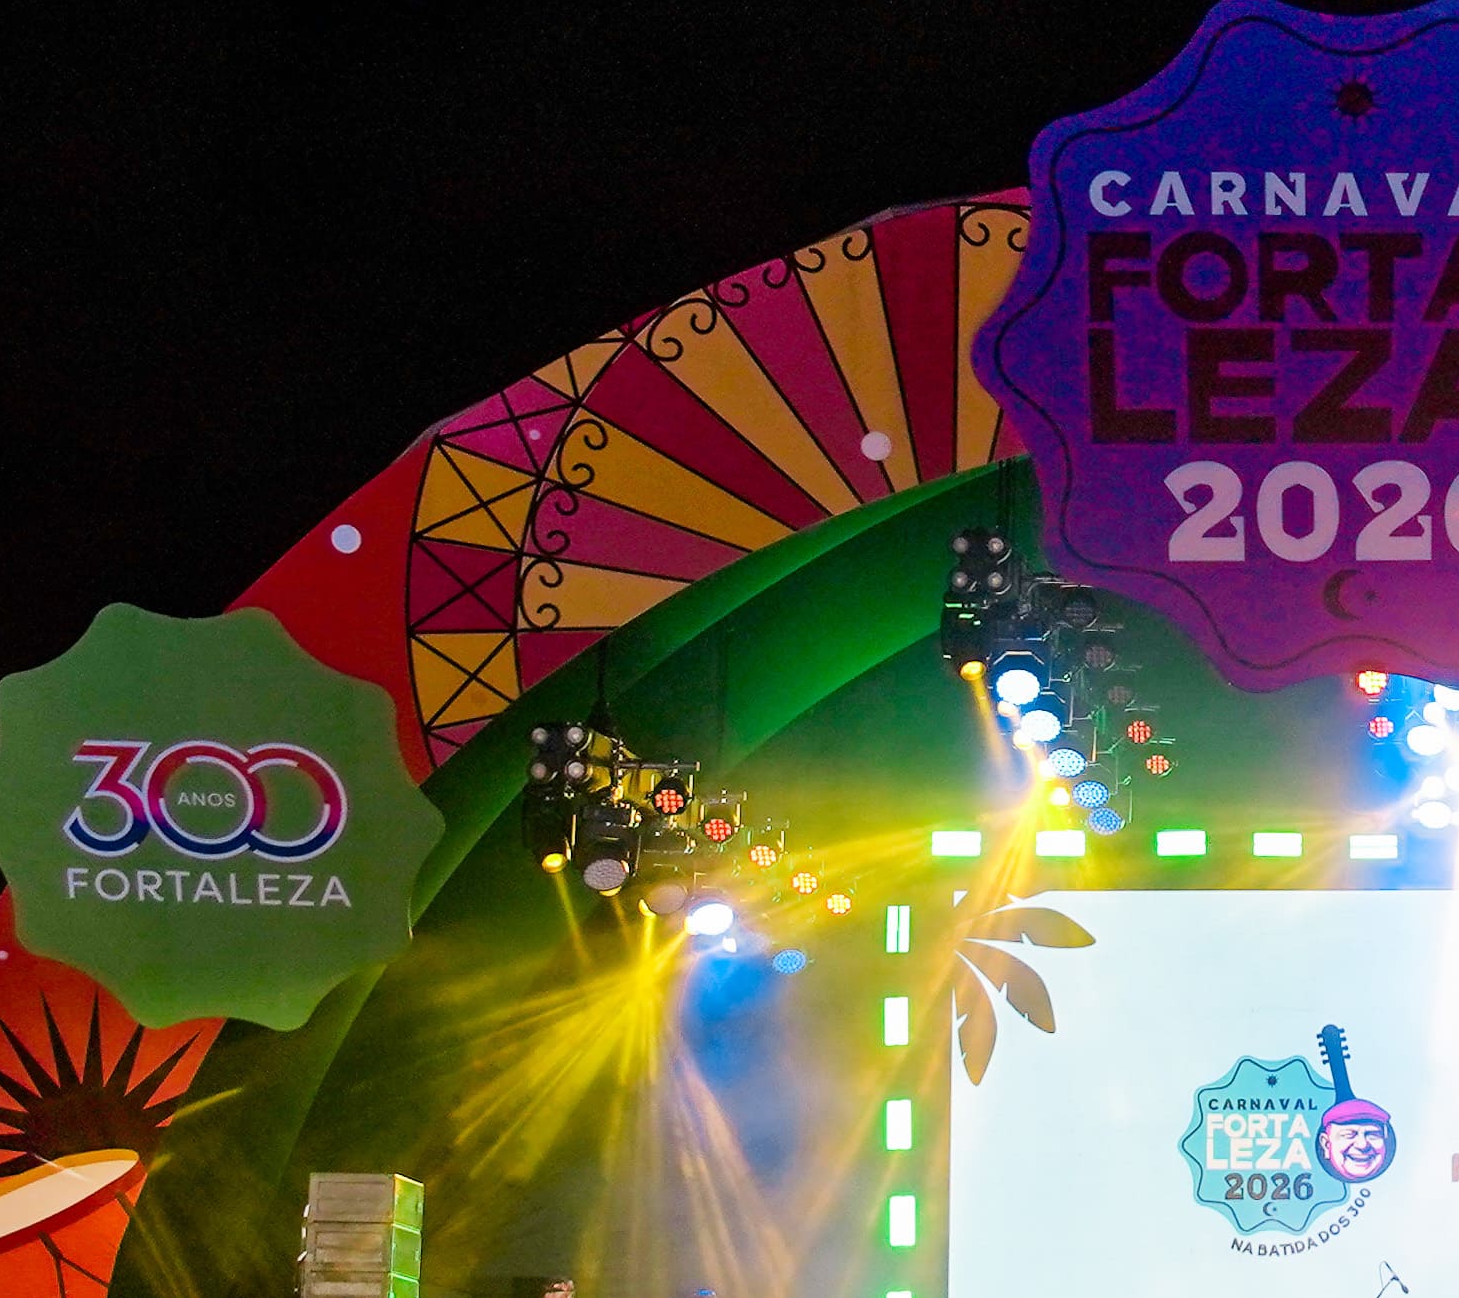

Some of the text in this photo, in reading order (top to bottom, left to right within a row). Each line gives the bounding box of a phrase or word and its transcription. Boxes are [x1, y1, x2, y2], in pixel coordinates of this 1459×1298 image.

[62, 739, 348, 864] 300
[177, 791, 237, 808] ANOS
[65, 867, 352, 908] FORTALEZA
[1208, 1098, 1318, 1111] CARNAVAL
[1206, 1113, 1311, 1138] FORTA
[1205, 1138, 1312, 1170] LEZA
[1224, 1172, 1314, 1200] 2026
[1231, 1187, 1371, 1257] NA BATIDA DOS 300
